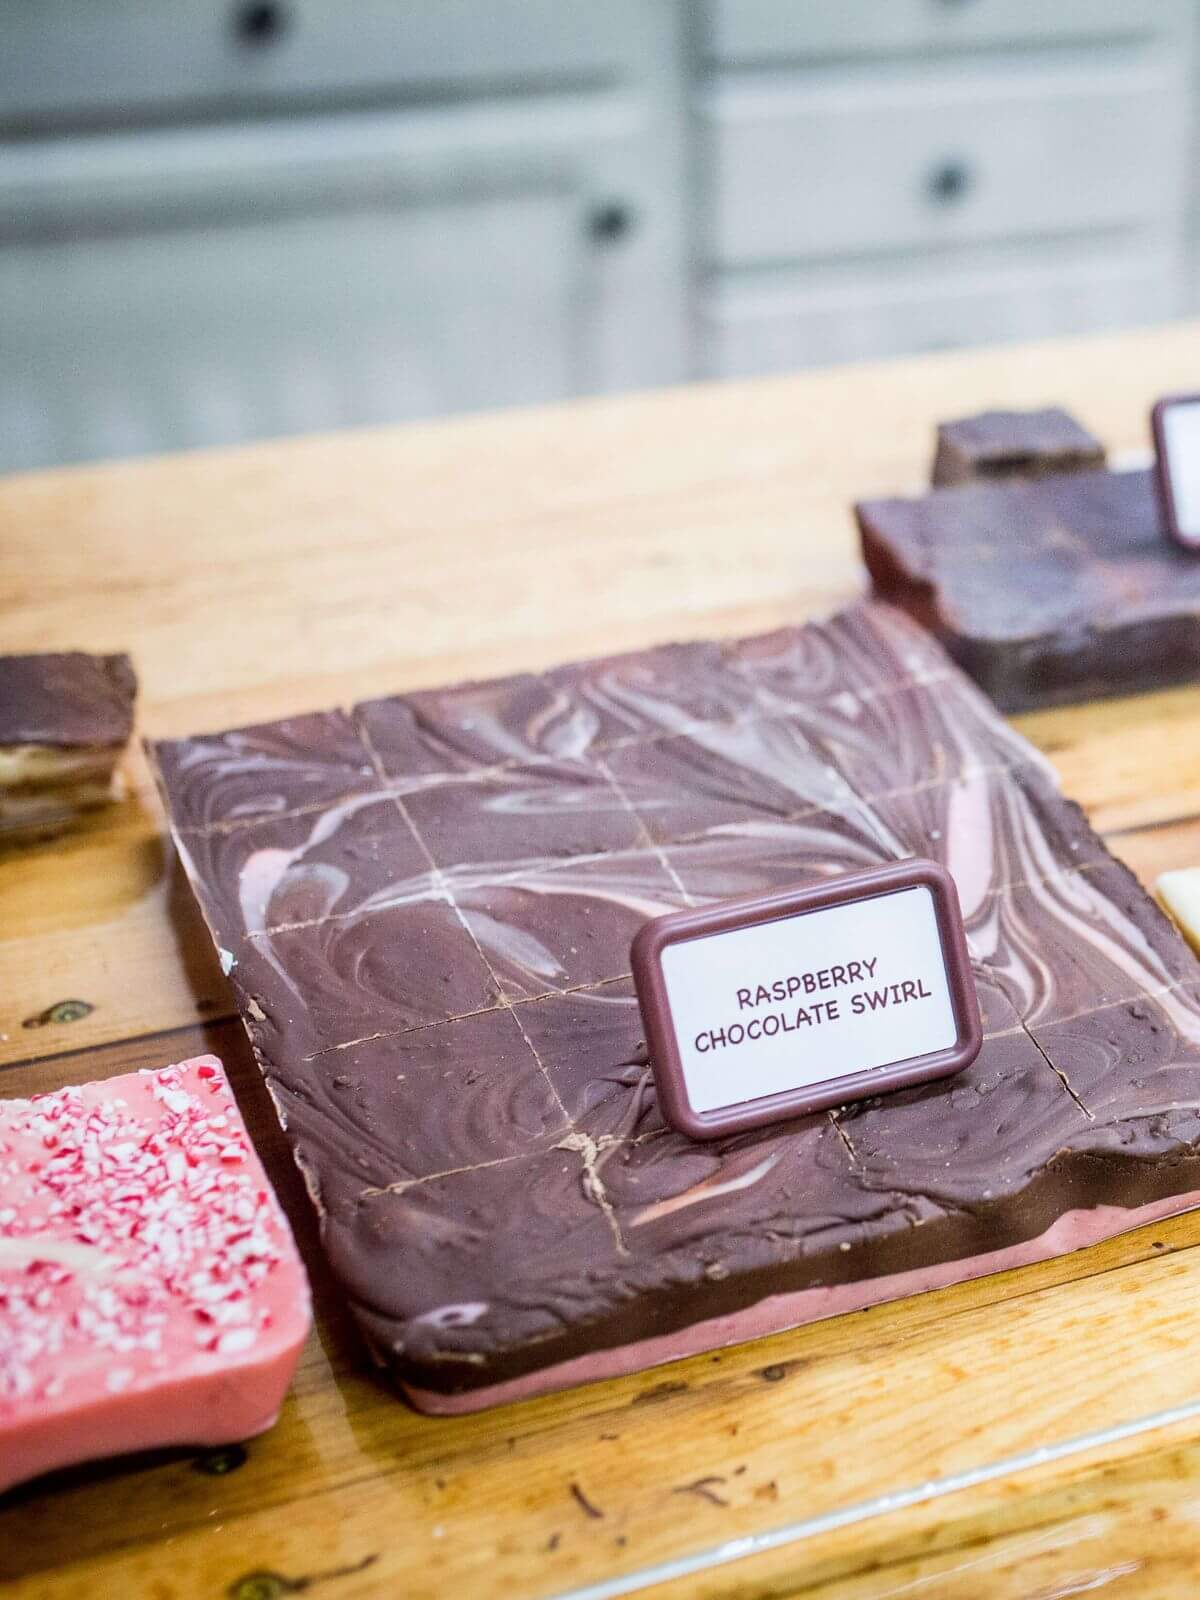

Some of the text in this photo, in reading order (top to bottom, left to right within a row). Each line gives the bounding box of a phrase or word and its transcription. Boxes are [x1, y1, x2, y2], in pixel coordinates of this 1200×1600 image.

[736, 956, 878, 1010] RASPBERRY
[694, 978, 932, 1053] CHOCOLATE SWIRL
